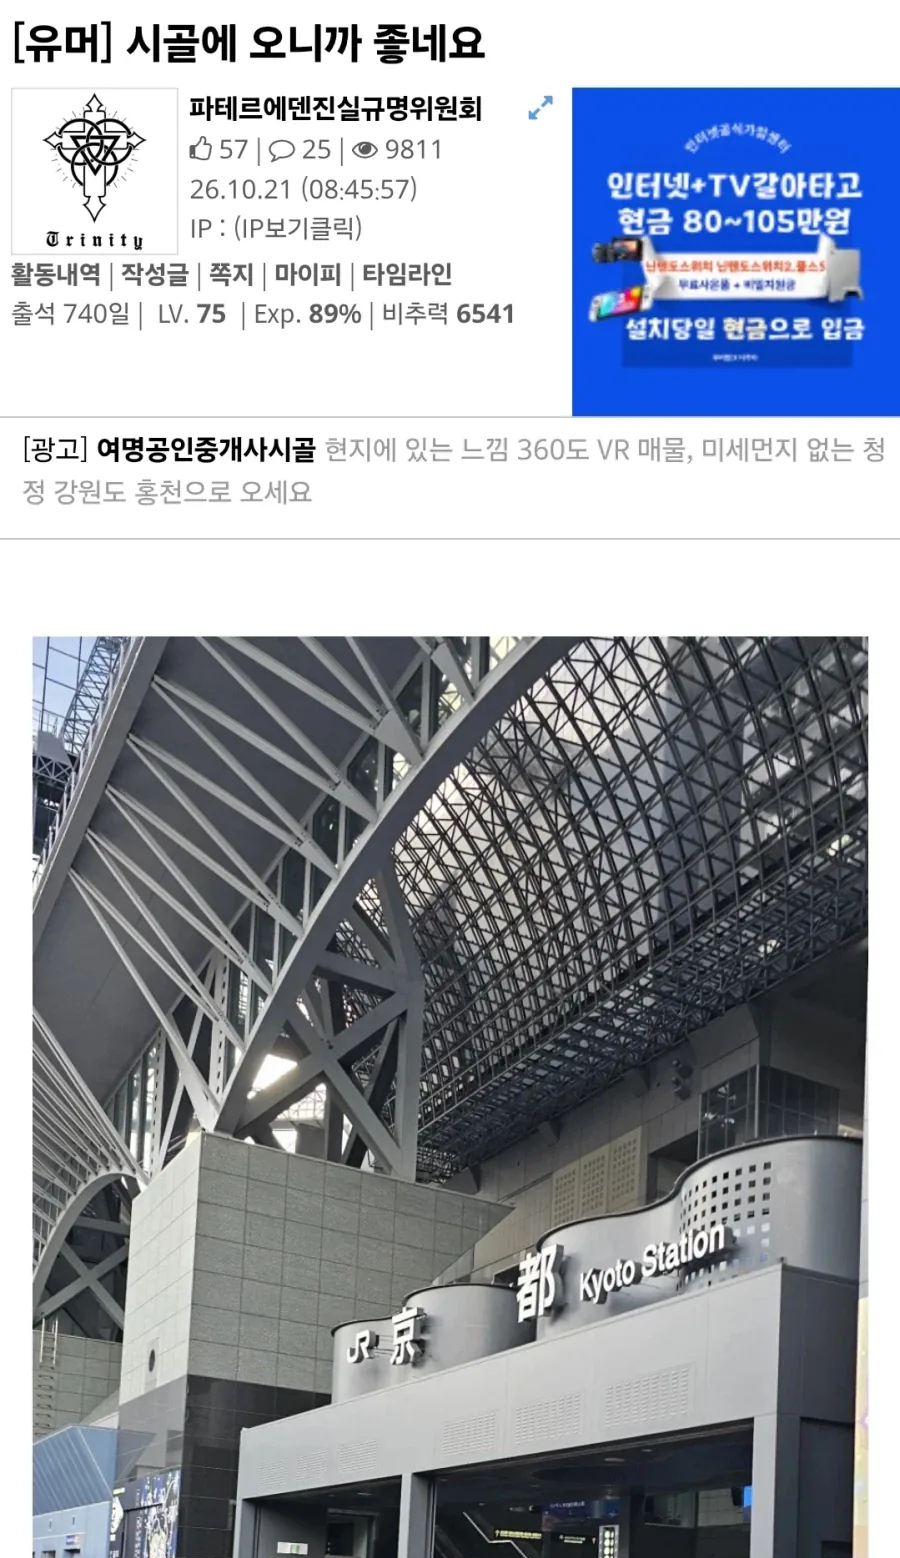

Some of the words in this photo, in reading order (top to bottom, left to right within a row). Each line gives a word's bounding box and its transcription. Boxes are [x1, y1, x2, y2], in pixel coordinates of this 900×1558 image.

[346, 1329, 370, 1363] JR
[390, 1306, 418, 1365] 京
[516, 1244, 557, 1323] 都
[579, 1260, 635, 1304] Kyoto
[641, 1223, 725, 1277] Station
